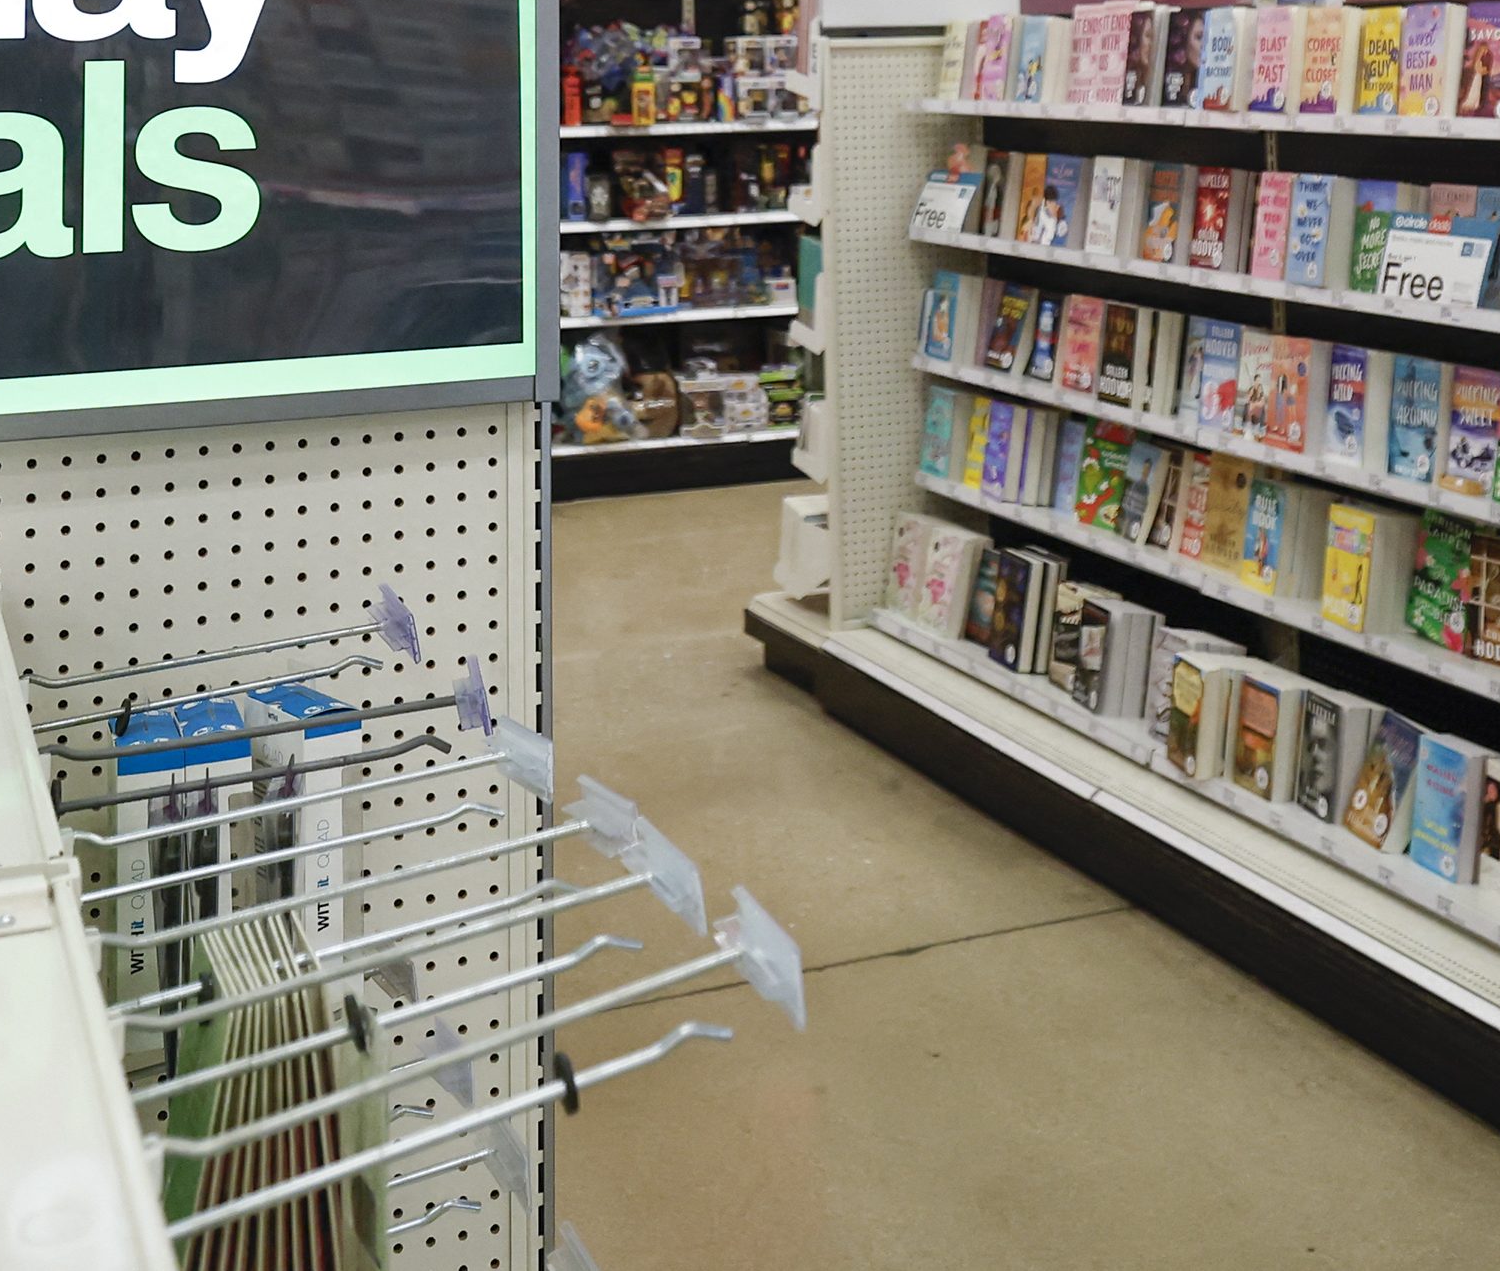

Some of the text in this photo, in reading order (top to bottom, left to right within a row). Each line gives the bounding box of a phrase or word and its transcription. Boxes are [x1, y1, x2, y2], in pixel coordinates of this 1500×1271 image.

[1260, 37, 1286, 51] BLAST
[1369, 40, 1395, 55] DEAD
[1370, 59, 1391, 77] GUY
[1406, 51, 1430, 69] BEST
[1258, 65, 1284, 83] PAST
[1409, 74, 1433, 91] MAN
[912, 200, 947, 230] Free
[1380, 262, 1444, 301] Free
[317, 875, 330, 932] WITit
